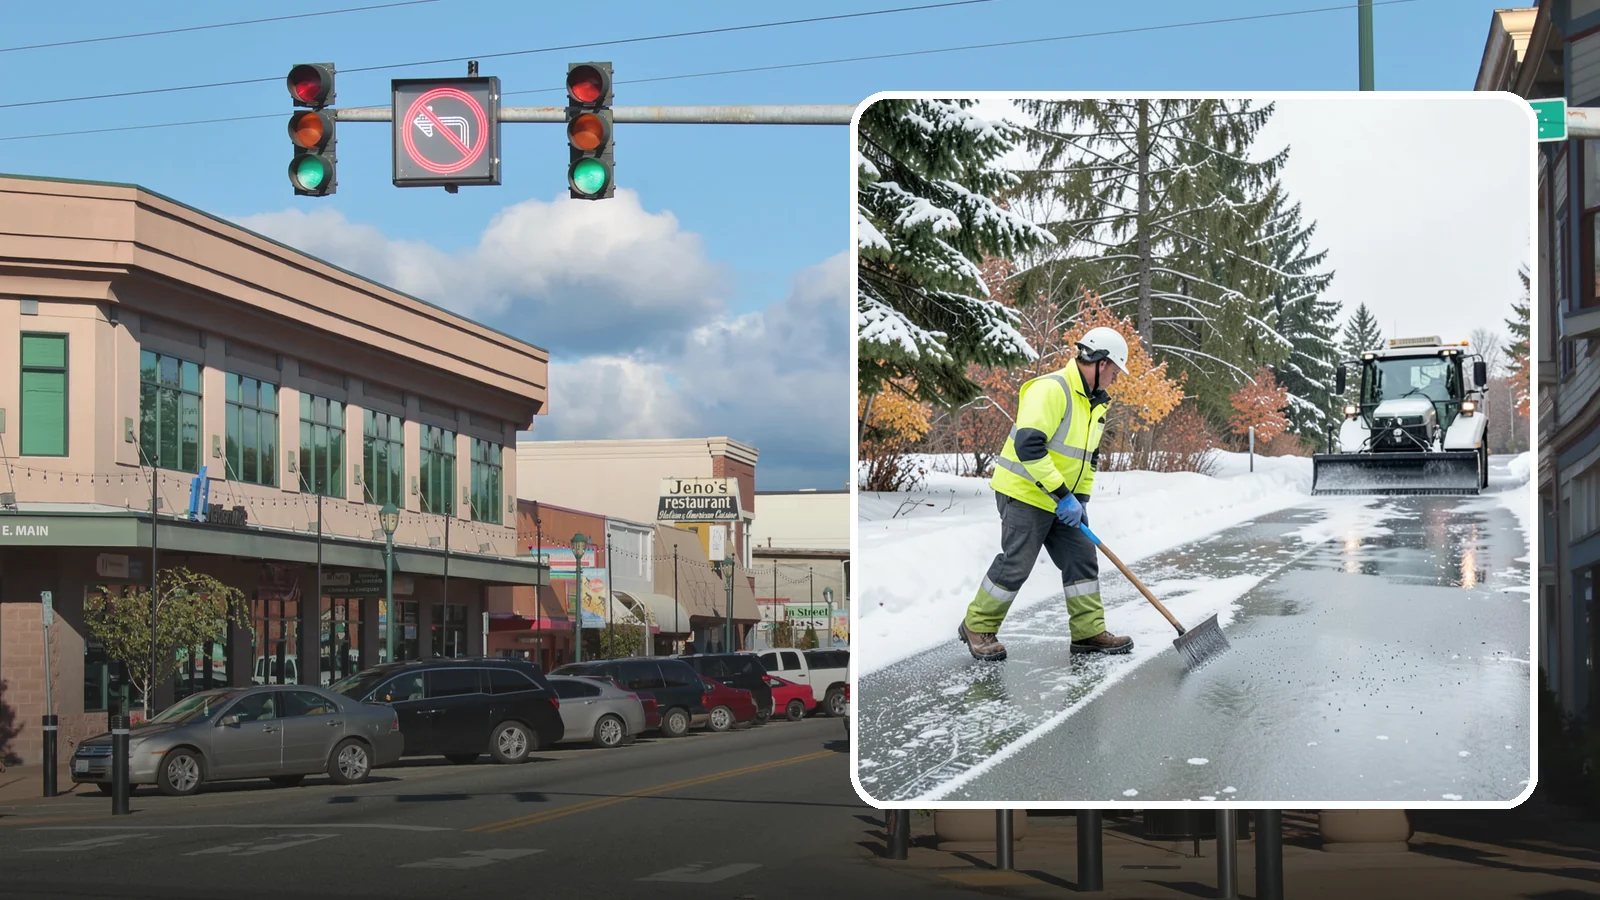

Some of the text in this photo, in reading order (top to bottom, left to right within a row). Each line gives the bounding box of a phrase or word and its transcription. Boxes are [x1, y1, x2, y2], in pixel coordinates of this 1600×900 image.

[670, 480, 727, 494] Jeno's
[665, 496, 731, 509] restaurant
[686, 510, 714, 519] American
[715, 509, 737, 519] Cuisine
[2, 525, 49, 536] E. MAIN
[797, 607, 828, 617] Street
